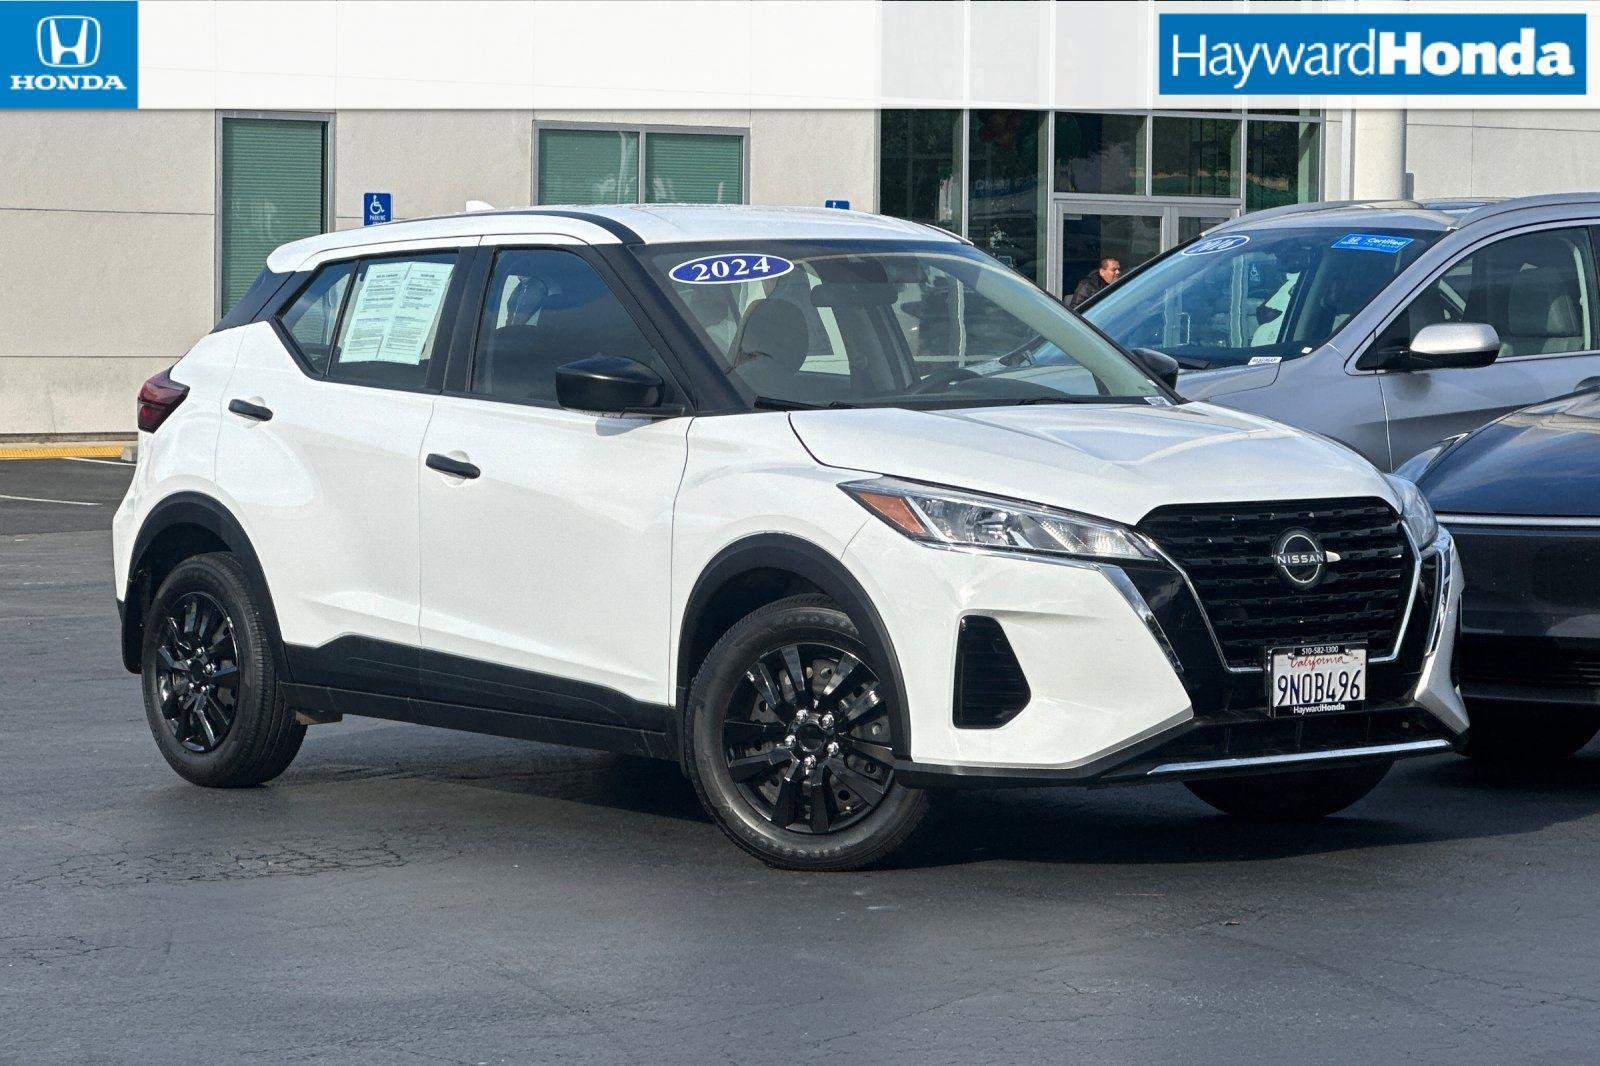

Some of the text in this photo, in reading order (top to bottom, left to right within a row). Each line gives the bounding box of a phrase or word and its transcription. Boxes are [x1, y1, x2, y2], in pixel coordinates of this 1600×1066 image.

[691, 256, 771, 281] 2024
[1277, 553, 1324, 564] NISSAN
[1301, 646, 1339, 655] 510-582-1300
[1290, 655, 1350, 671] California
